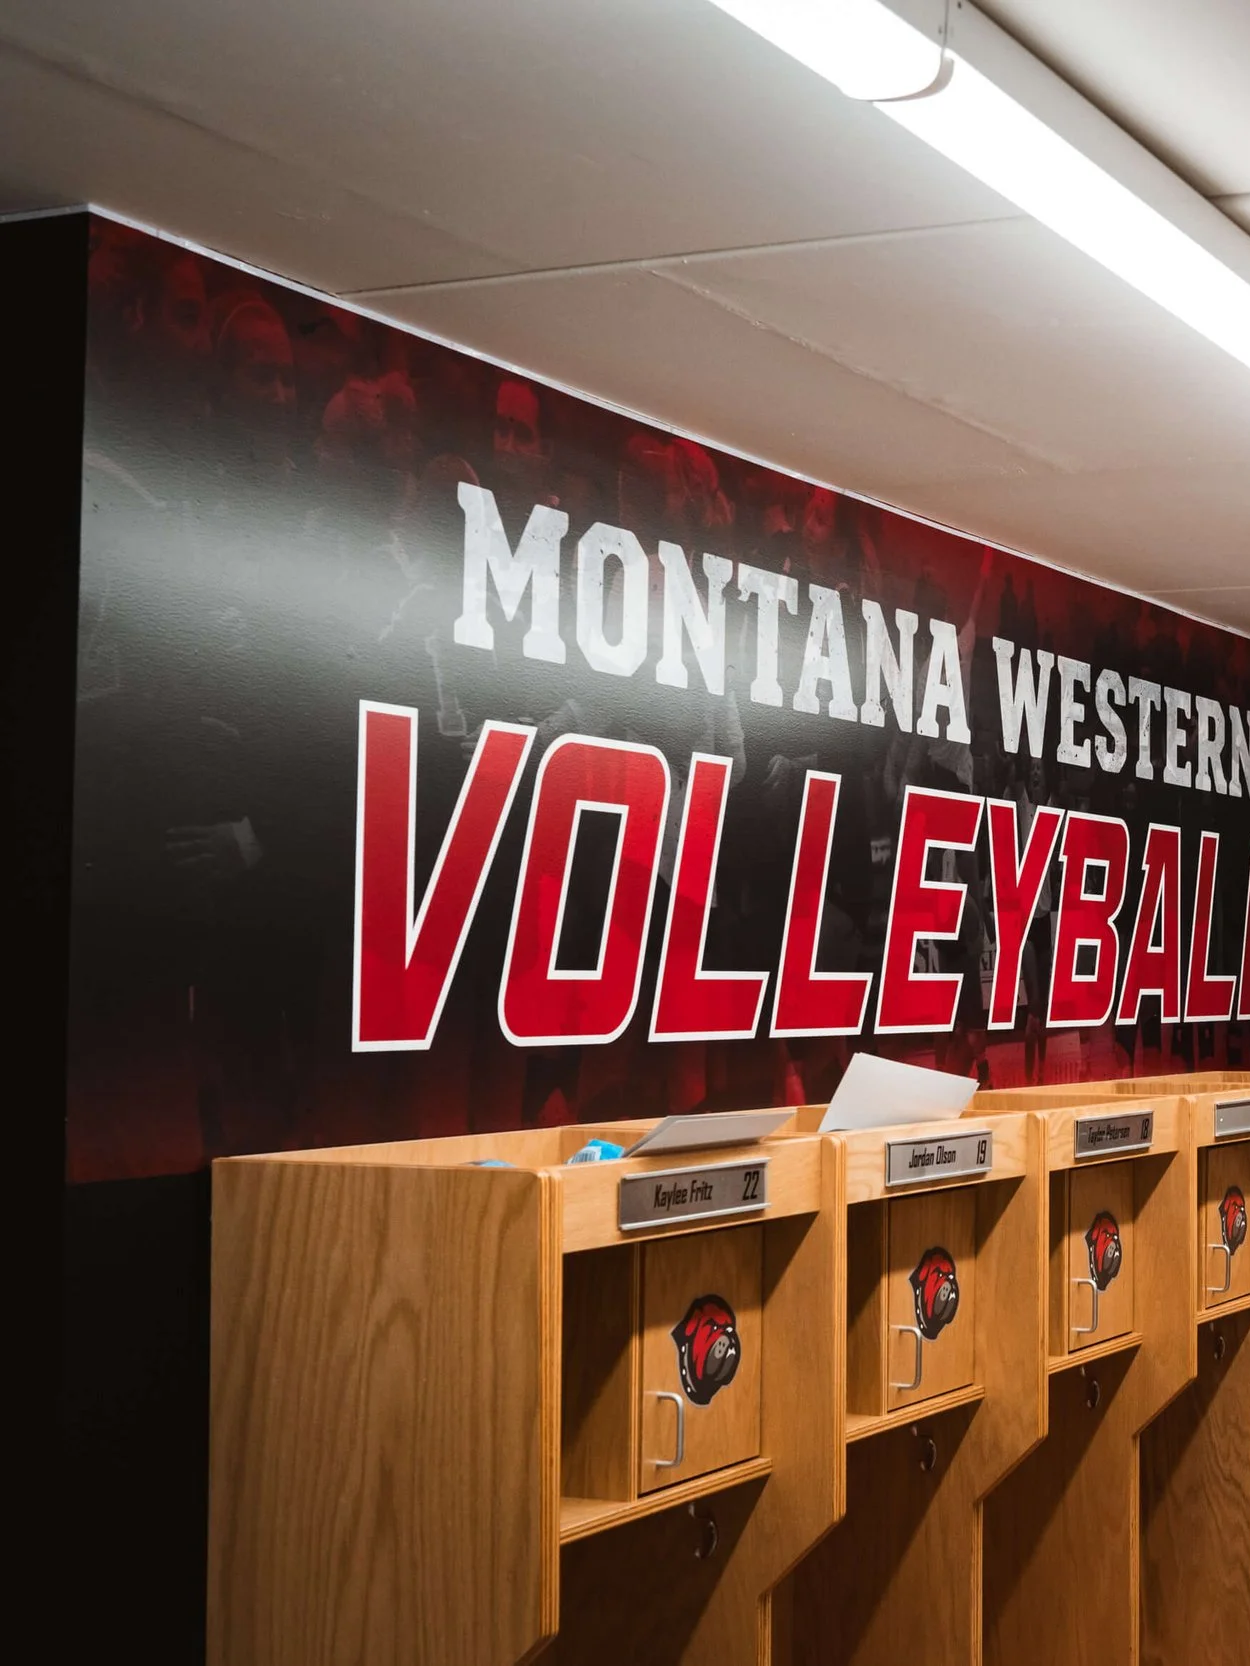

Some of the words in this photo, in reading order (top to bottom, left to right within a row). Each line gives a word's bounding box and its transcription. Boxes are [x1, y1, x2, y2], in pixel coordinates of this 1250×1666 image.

[454, 481, 971, 744] MONTANA
[1141, 1117, 1150, 1141] 18
[908, 1147, 935, 1169] Jordan
[935, 1144, 957, 1165] Olson
[976, 1139, 988, 1165] 19
[653, 1182, 689, 1212] Kaylee
[689, 1179, 714, 1203] Fritz
[742, 1169, 760, 1201] 22
